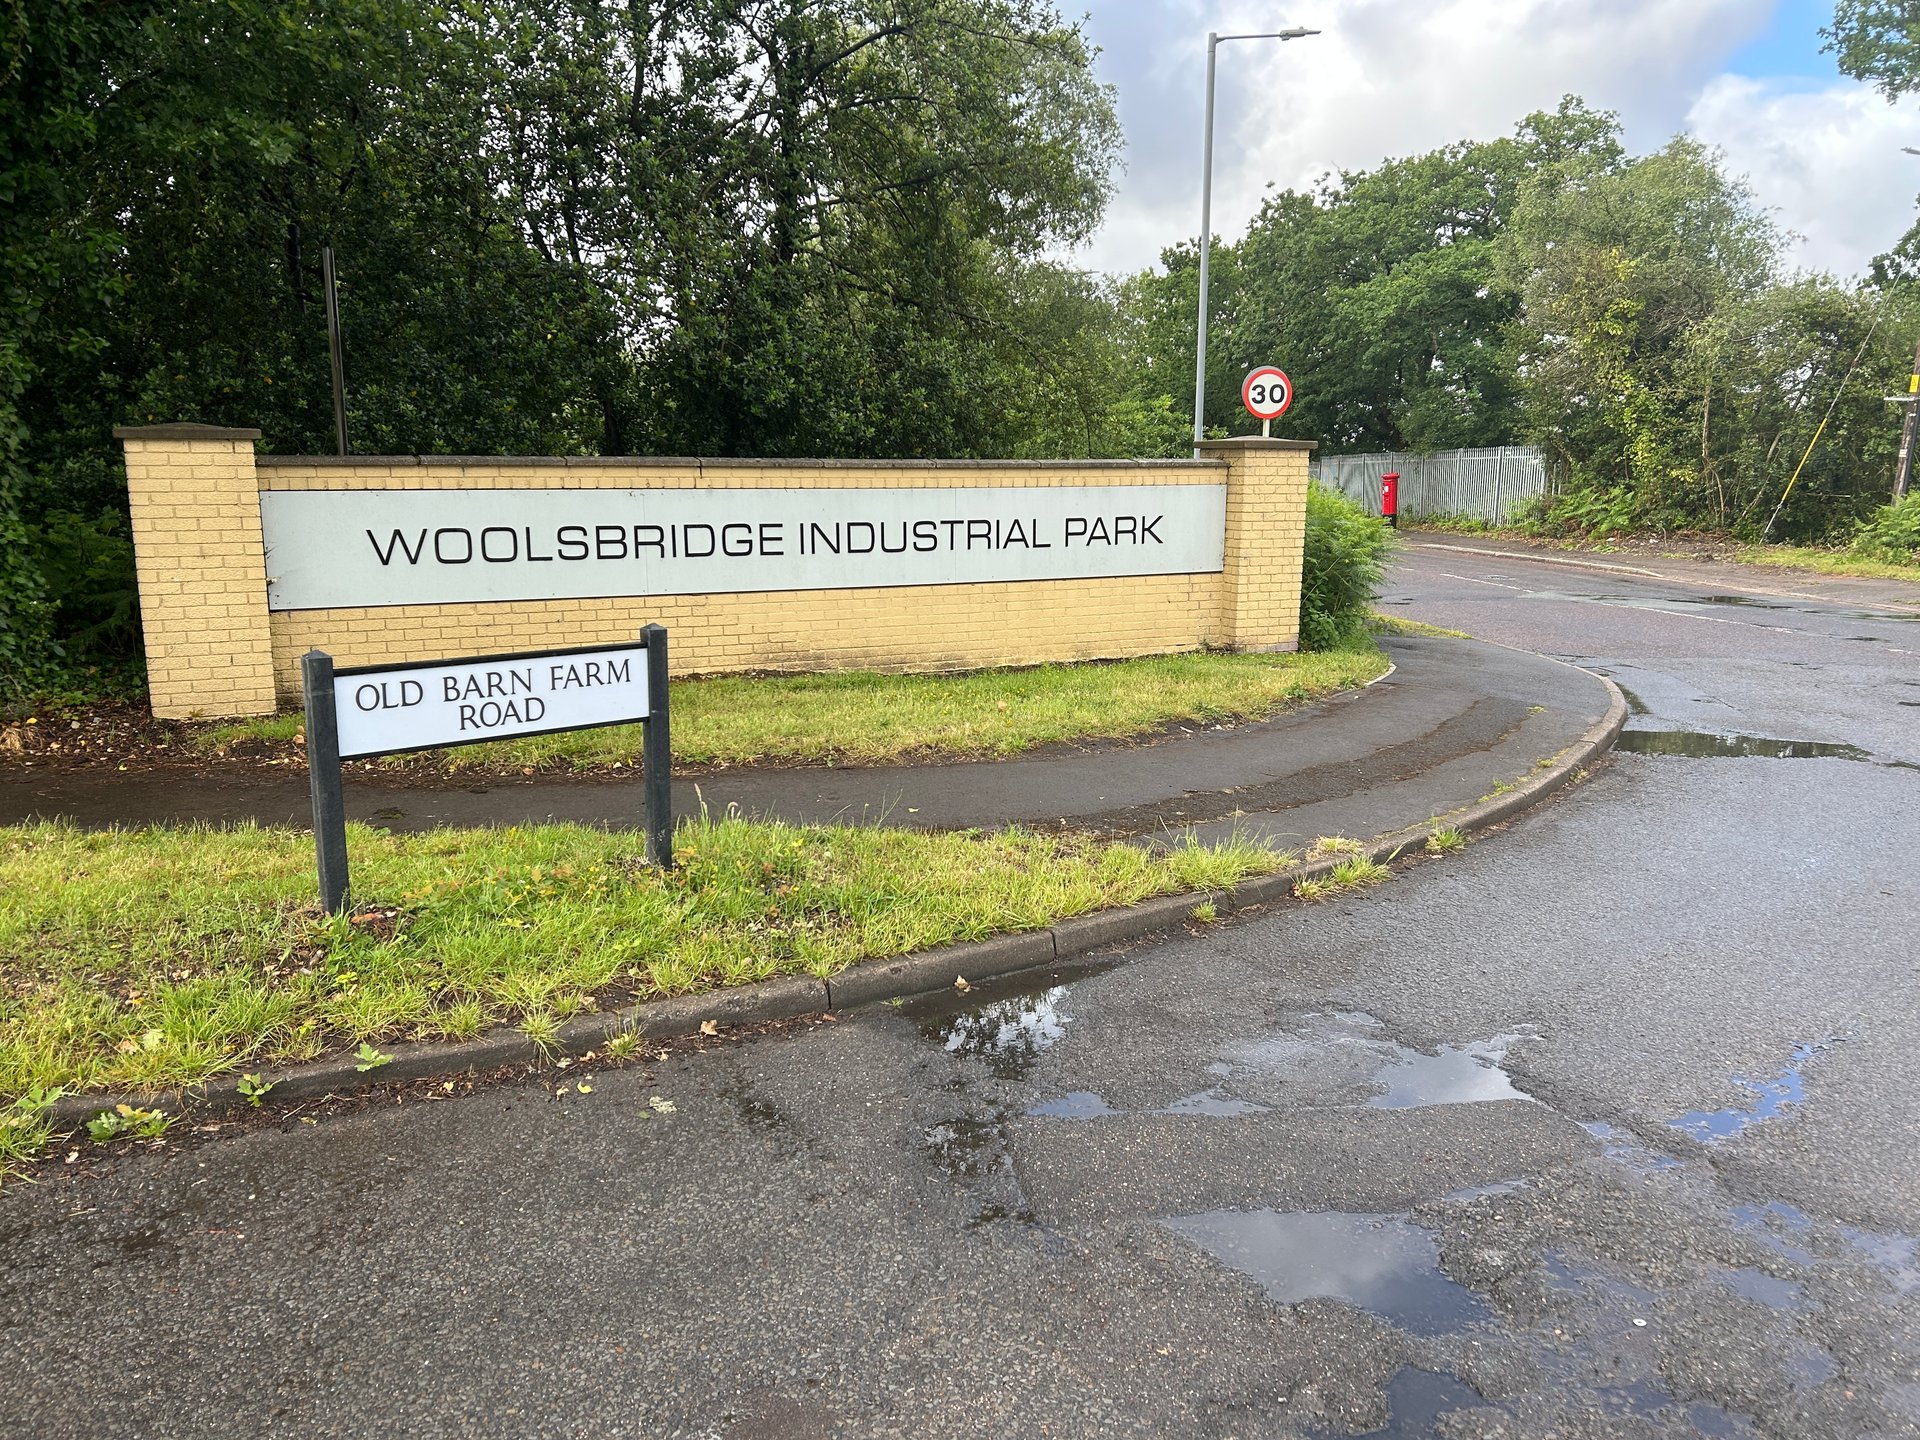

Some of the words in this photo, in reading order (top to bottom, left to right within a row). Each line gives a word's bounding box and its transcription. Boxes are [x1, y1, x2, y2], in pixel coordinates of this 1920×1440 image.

[1251, 383, 1285, 405] 30
[365, 523, 786, 566] WOOLSBRIDGE
[799, 518, 1052, 555] INDUSTRIAL
[1064, 515, 1164, 548] PARK
[355, 680, 424, 712] OLD
[443, 668, 532, 702] BARN
[550, 658, 631, 691] FARM
[459, 697, 545, 731] ROAD
